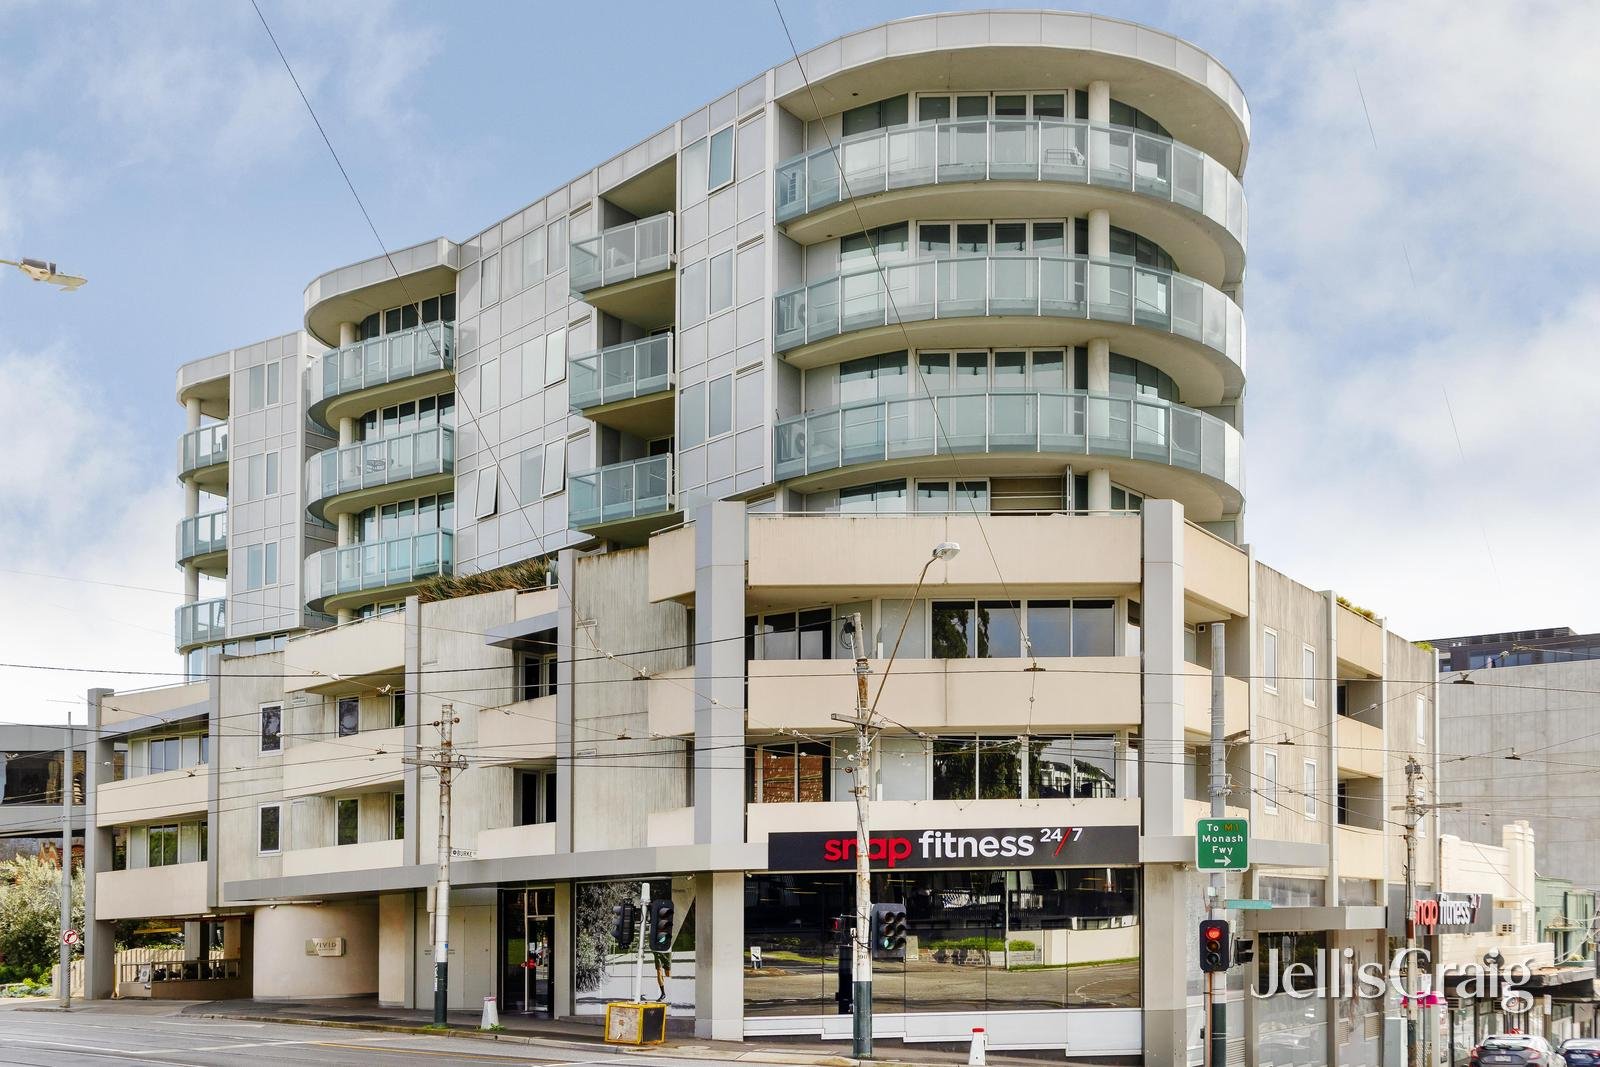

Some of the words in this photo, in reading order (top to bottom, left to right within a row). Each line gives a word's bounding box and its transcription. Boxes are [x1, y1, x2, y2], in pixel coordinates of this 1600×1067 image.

[1206, 823, 1219, 832] To
[1224, 823, 1239, 832] M1
[1202, 834, 1244, 843] Monash
[824, 837, 912, 868] snap
[918, 830, 1035, 859] fitness
[1039, 826, 1083, 857] 24/7
[1212, 845, 1233, 856] Fwy
